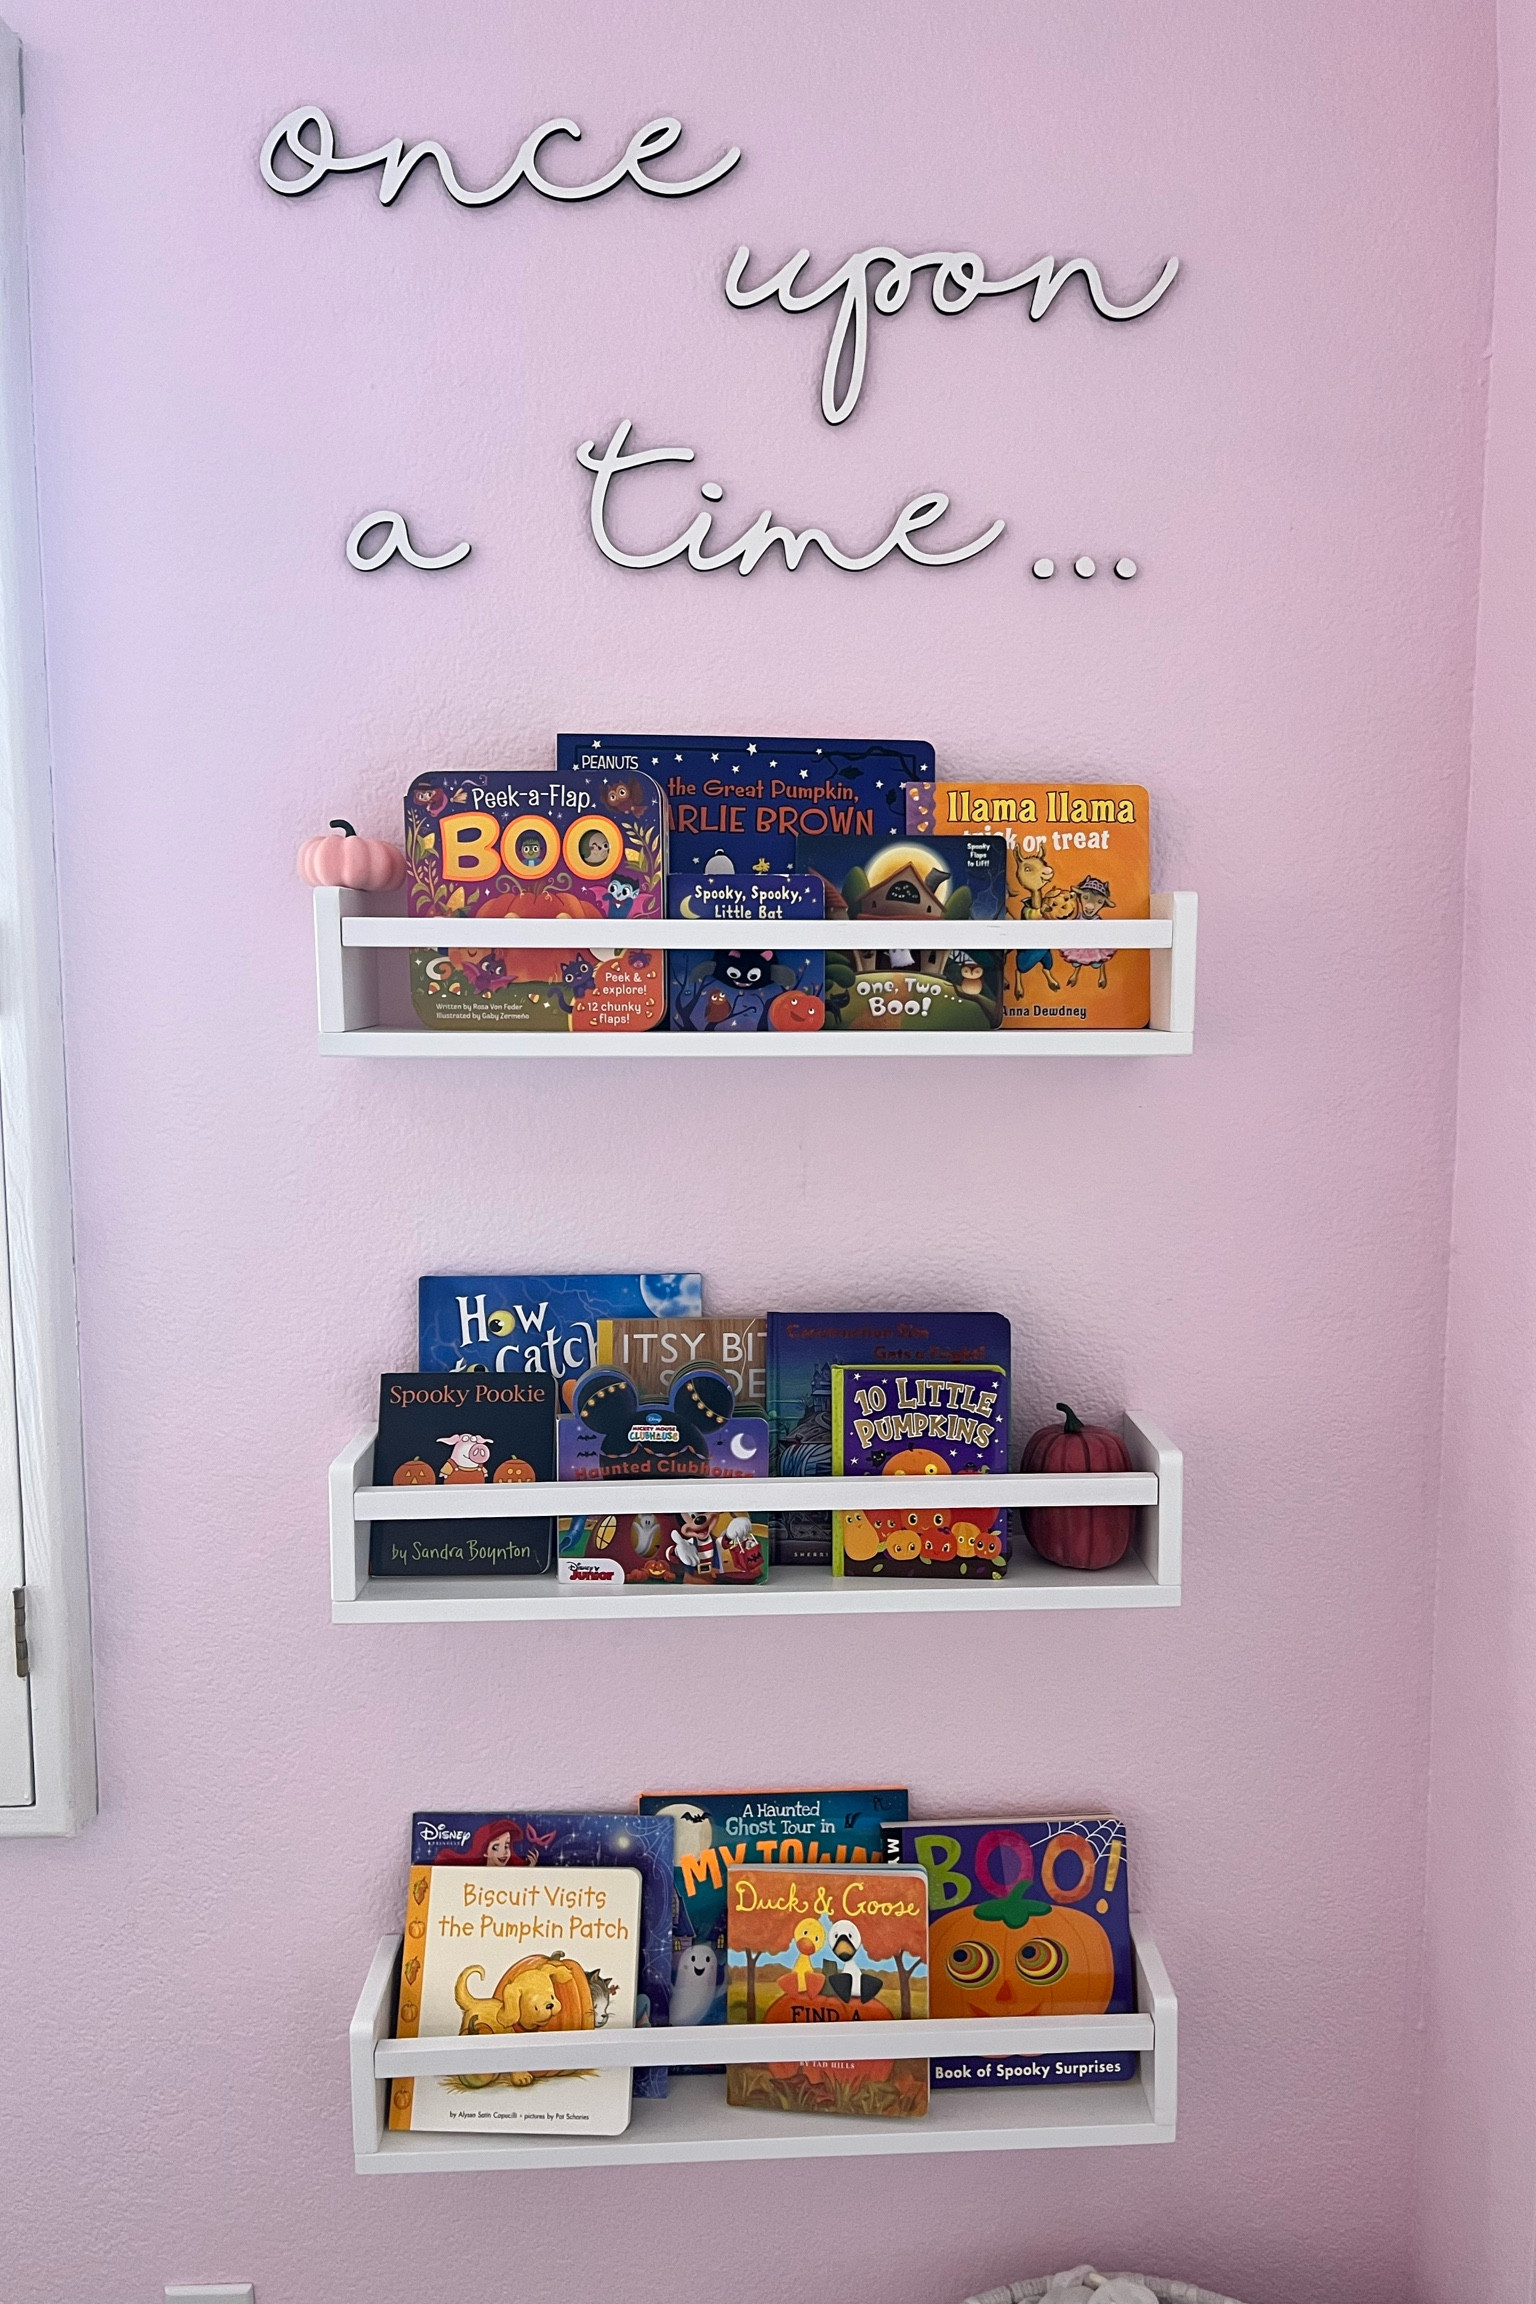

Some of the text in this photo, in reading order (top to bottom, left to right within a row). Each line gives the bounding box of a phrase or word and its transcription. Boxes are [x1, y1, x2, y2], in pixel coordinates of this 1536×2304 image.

[260, 105, 742, 206] once
[725, 245, 1179, 424] upon
[346, 507, 472, 572] a
[581, 755, 639, 770] PEANUTS
[471, 784, 591, 812] Peek-a-Flap
[667, 776, 860, 804] the Great Pumpkin,
[947, 790, 1136, 823] llama llama
[755, 805, 874, 838] BROWN
[439, 811, 624, 882] BOO
[967, 842, 991, 851] Spooky
[1022, 833, 1047, 853] or
[1052, 830, 1110, 851] treat
[970, 851, 987, 860] Flaps
[694, 885, 802, 905] Spooky, Spooky,
[714, 905, 783, 919] Little Bat
[605, 972, 642, 983] Peek &
[602, 984, 647, 997] explore!
[463, 1003, 472, 1011] by
[472, 1012, 481, 1020] by
[482, 1012, 499, 1020] Gaby
[587, 1001, 642, 1015] 12 chunky
[868, 996, 932, 1018] Boo!
[1002, 1005, 1087, 1019] Anna Dewdney
[599, 1012, 630, 1027] flaps!
[455, 1293, 549, 1348] How
[623, 1332, 767, 1364] ITSY BI
[874, 1345, 911, 1361] Gets
[390, 1384, 545, 1408] Spooky Pookie
[854, 1377, 998, 1418] 10 LITTLE
[853, 1413, 995, 1449] PUMPKINS
[573, 1460, 651, 1480] Haunted
[391, 1539, 530, 1566] by Sandra Boynton
[742, 1801, 820, 1819] A Haunted
[417, 1821, 471, 1847] Disney
[725, 1817, 836, 1837] Ghost Tour in
[914, 1829, 1122, 1915] BOO!
[463, 1883, 607, 1909] Biscuit Visits
[735, 1880, 920, 1917] Duck & Goose
[438, 1914, 629, 1944] the Pumpkin Patch
[791, 2005, 840, 2023] FIND
[831, 2061, 855, 2069] HILLS
[935, 2059, 1122, 2080] Book of Spooky Surprises
[449, 2111, 457, 2119] by
[478, 2111, 492, 2119] Satin
[523, 2112, 545, 2121] pictures
[546, 2112, 554, 2121] by
